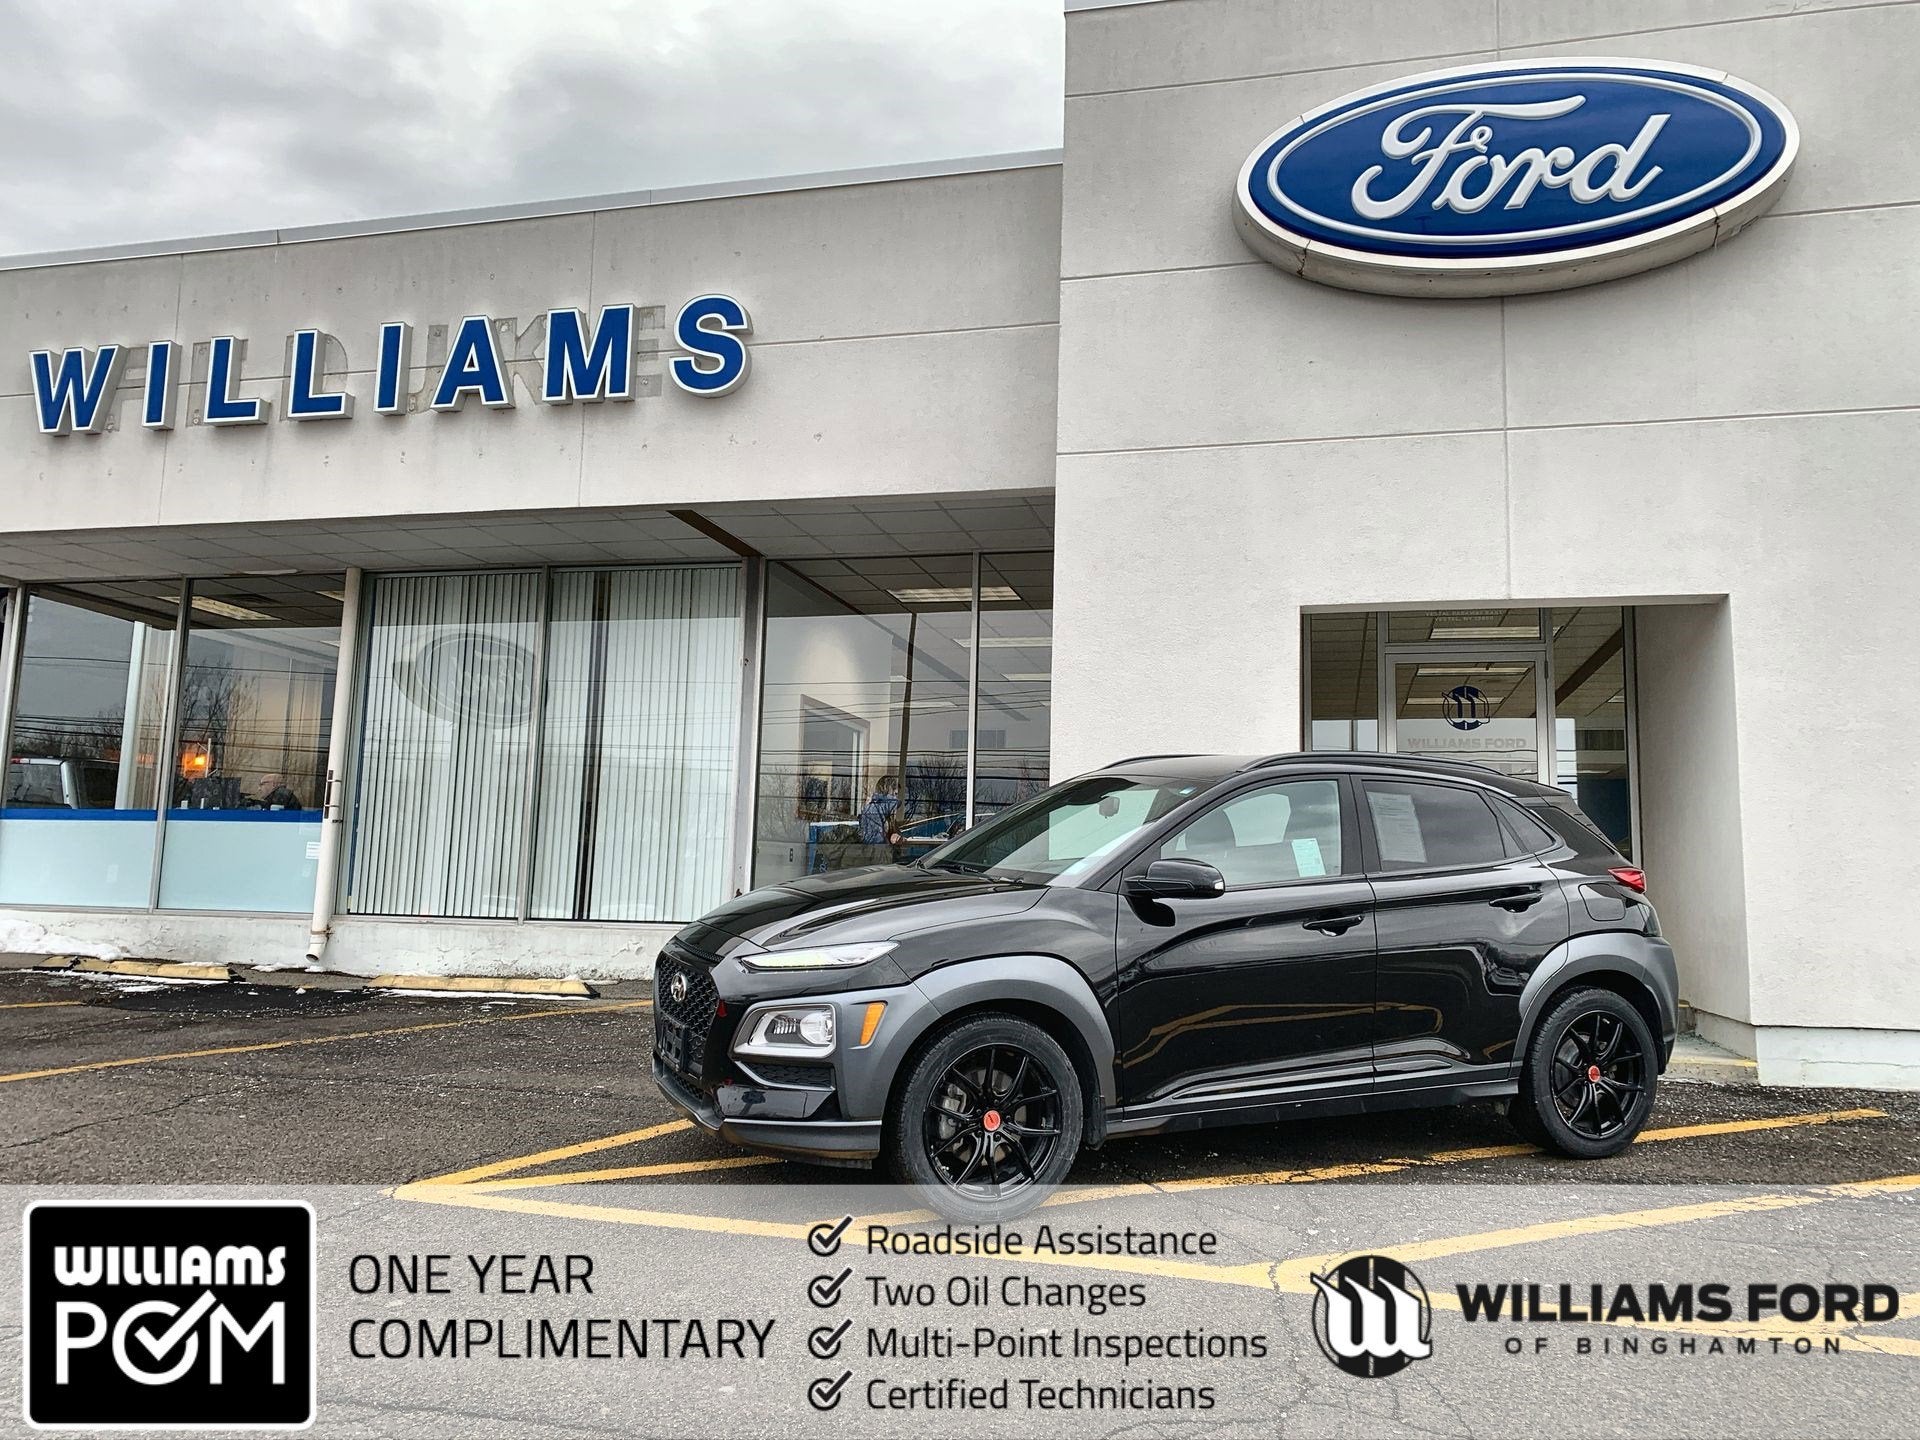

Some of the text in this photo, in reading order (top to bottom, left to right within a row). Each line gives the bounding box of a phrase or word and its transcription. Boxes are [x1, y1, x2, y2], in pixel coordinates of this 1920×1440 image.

[1350, 94, 1671, 221] Ford
[28, 293, 754, 437] WILLIAMS
[1407, 737, 1527, 749] WILLIAMS FORD
